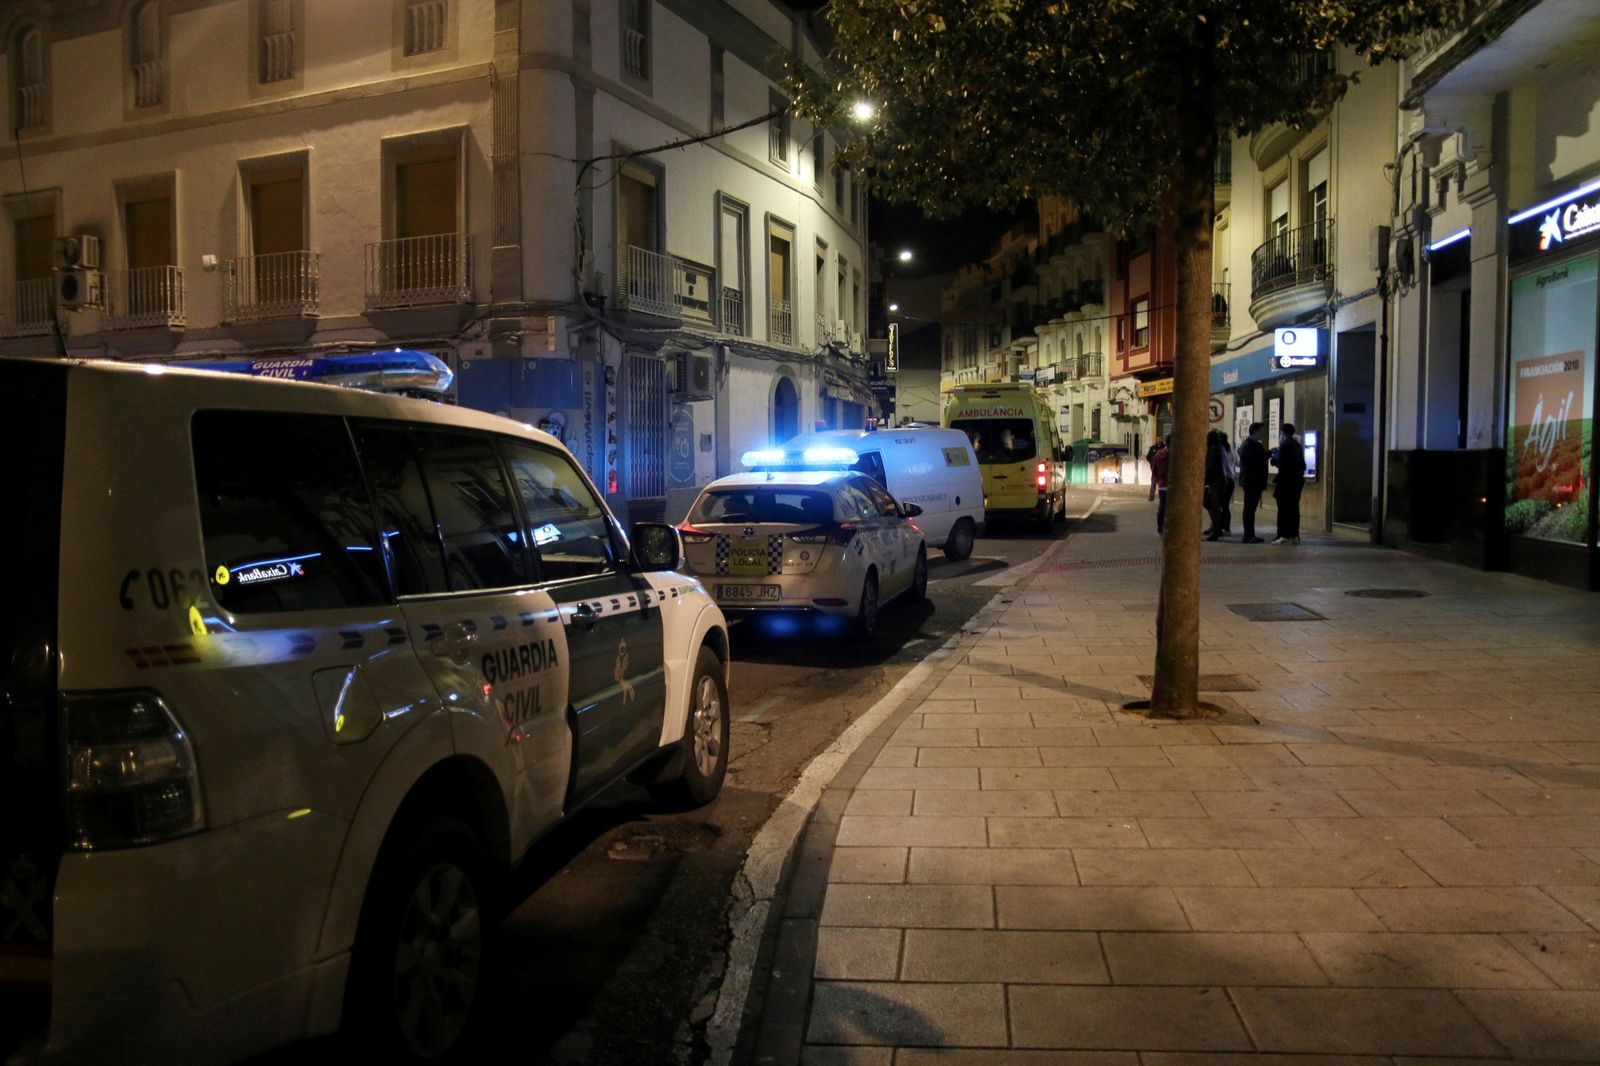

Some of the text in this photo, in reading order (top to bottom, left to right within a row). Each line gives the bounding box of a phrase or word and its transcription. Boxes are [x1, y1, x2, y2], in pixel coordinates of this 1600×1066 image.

[253, 359, 313, 369] GUARDIA
[260, 369, 296, 378] CIVIL
[958, 408, 1024, 418] AMBULANCIA
[733, 558, 763, 567] LOCAL
[725, 586, 777, 598] 6845 JHZ
[482, 638, 558, 686] GUARDIA
[504, 685, 542, 724] CIVIL
